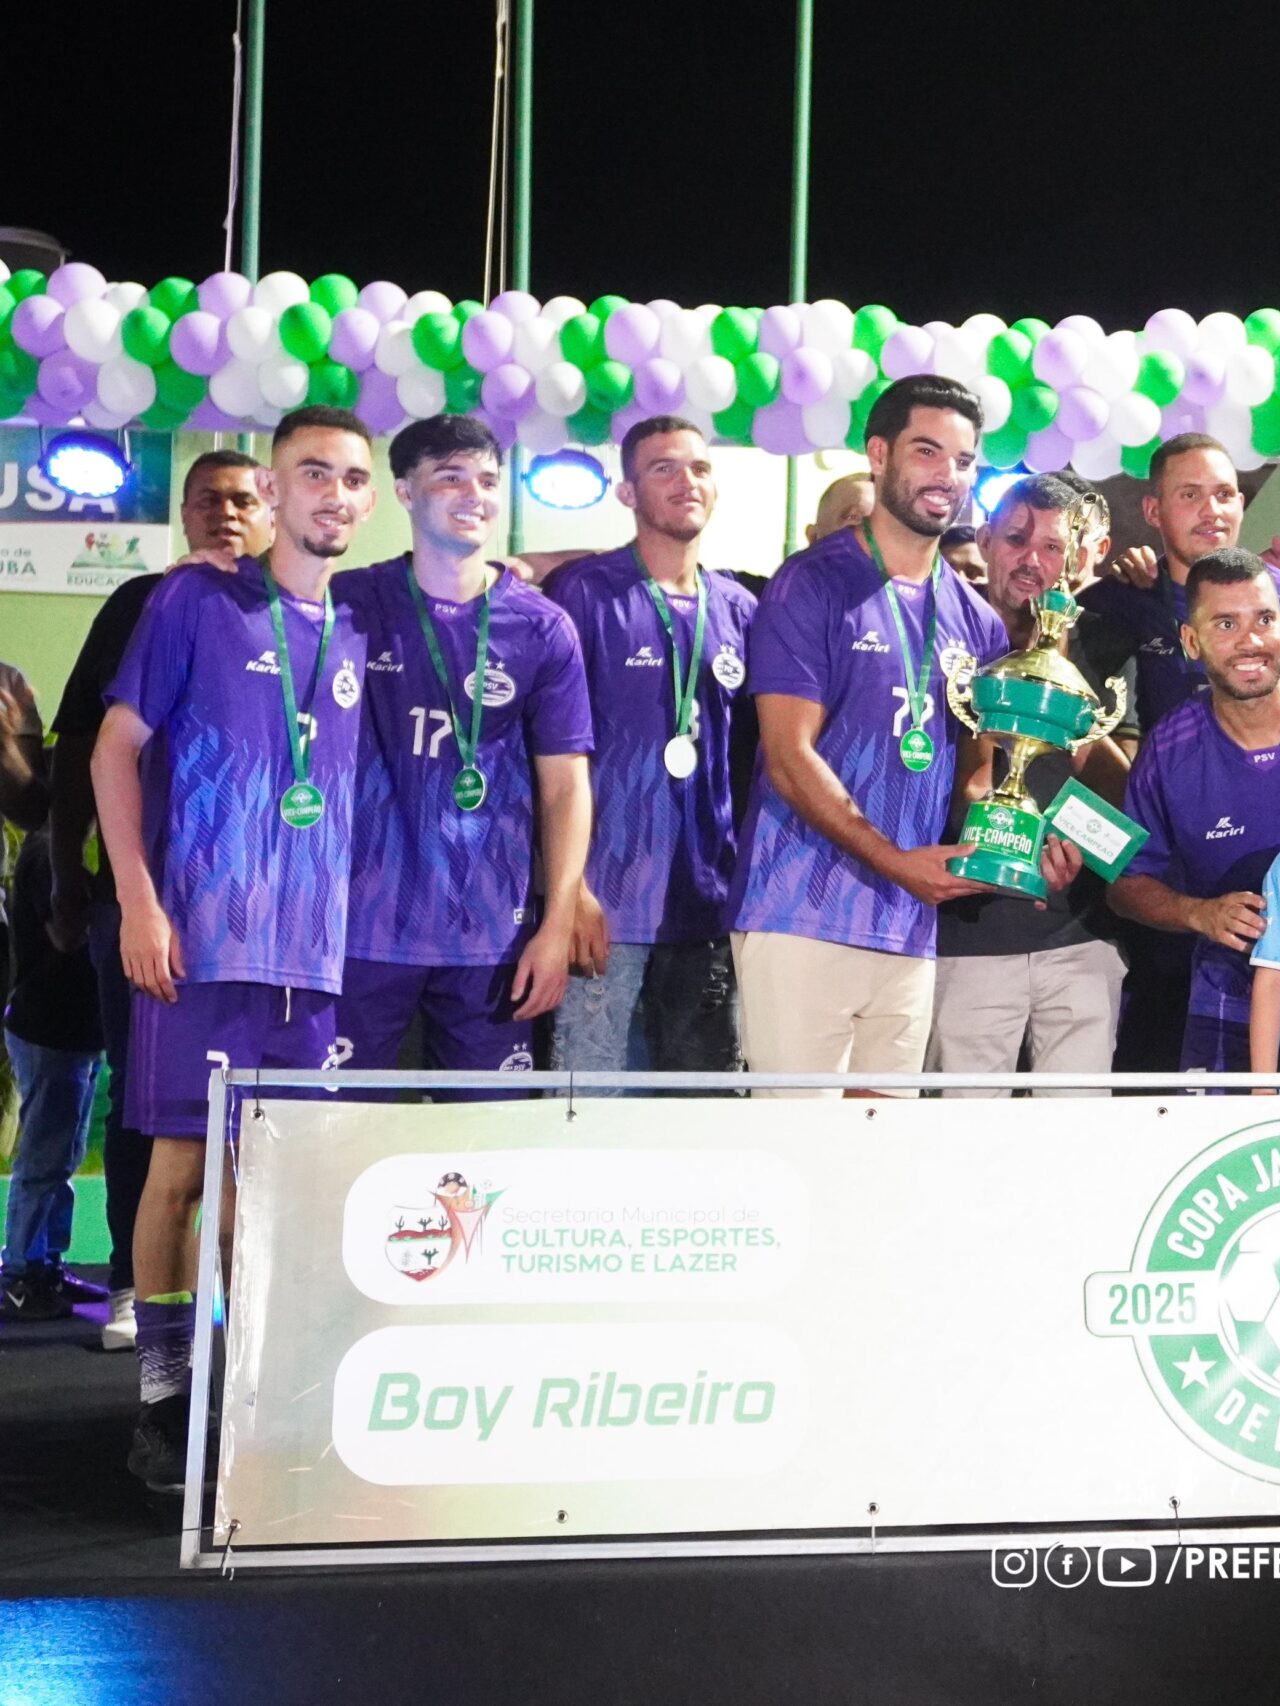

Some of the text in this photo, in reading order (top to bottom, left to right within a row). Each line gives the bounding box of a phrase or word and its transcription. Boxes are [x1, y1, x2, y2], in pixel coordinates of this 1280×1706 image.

[434, 603, 457, 615] PSV
[245, 660, 282, 675] Karir
[408, 706, 453, 759] 17
[1253, 752, 1276, 763] PSV
[964, 826, 1033, 855] VICE-CAMPEÃO
[1205, 825, 1246, 840] Kariri
[502, 1204, 760, 1226] Secretaria Municipal de
[1166, 1174, 1249, 1260] COPA
[501, 1226, 782, 1249] CULTURA, ESPORTES,
[500, 1252, 738, 1273] TURISMO E LAZER
[1108, 1282, 1198, 1325] 2025
[367, 1370, 776, 1442] Boy Ribeiro
[1213, 1387, 1270, 1443] DE
